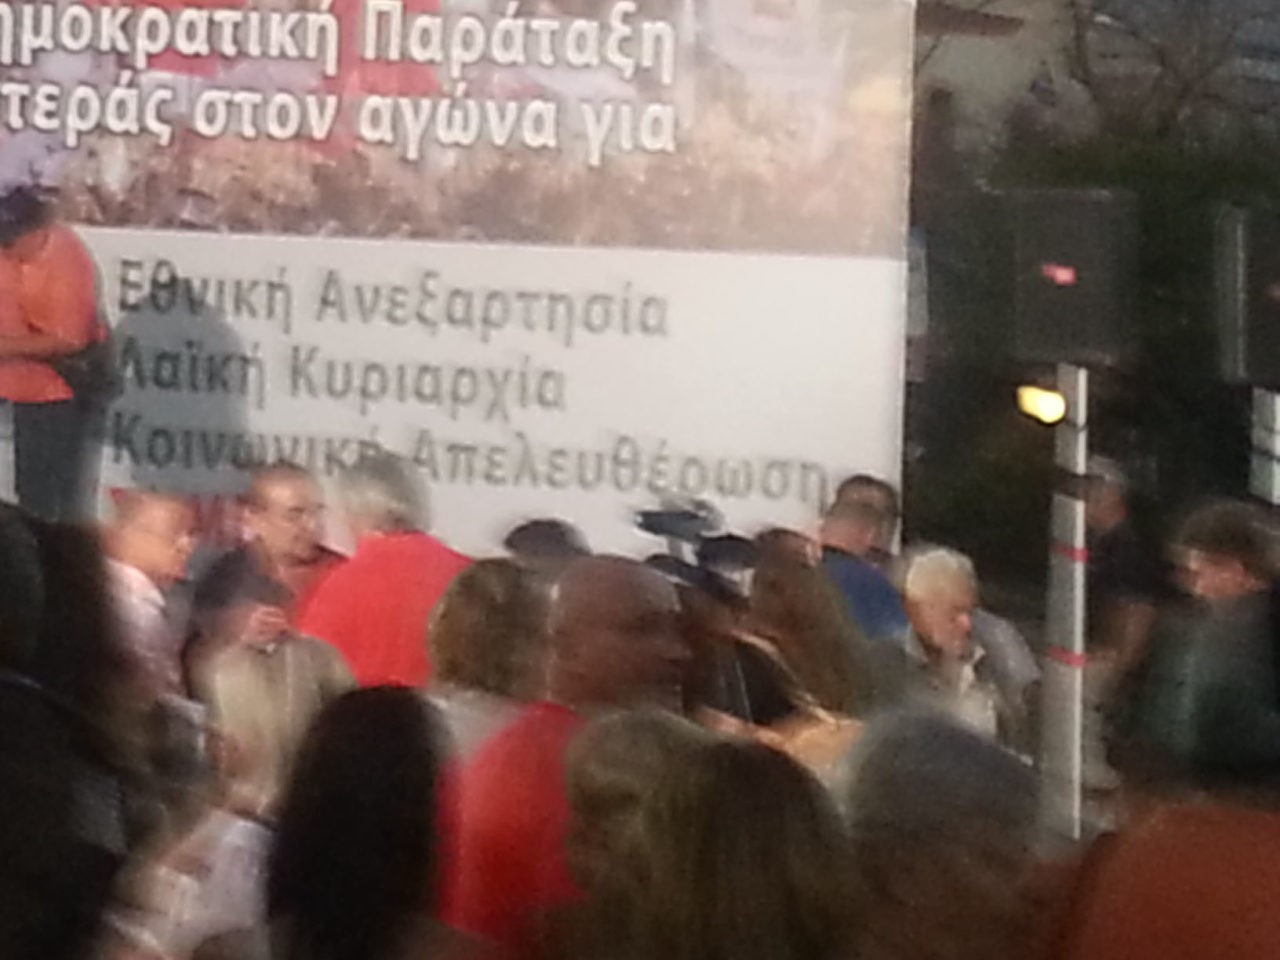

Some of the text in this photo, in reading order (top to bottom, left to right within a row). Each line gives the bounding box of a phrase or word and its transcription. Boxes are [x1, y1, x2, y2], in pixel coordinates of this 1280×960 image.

[194, 89, 338, 141] στον
[359, 81, 557, 161] αγώνα
[580, 102, 676, 167] για
[118, 258, 670, 347] Εθνική Ανεξαρτησία
[118, 337, 567, 422] Λαϊκή Κυριαρχία
